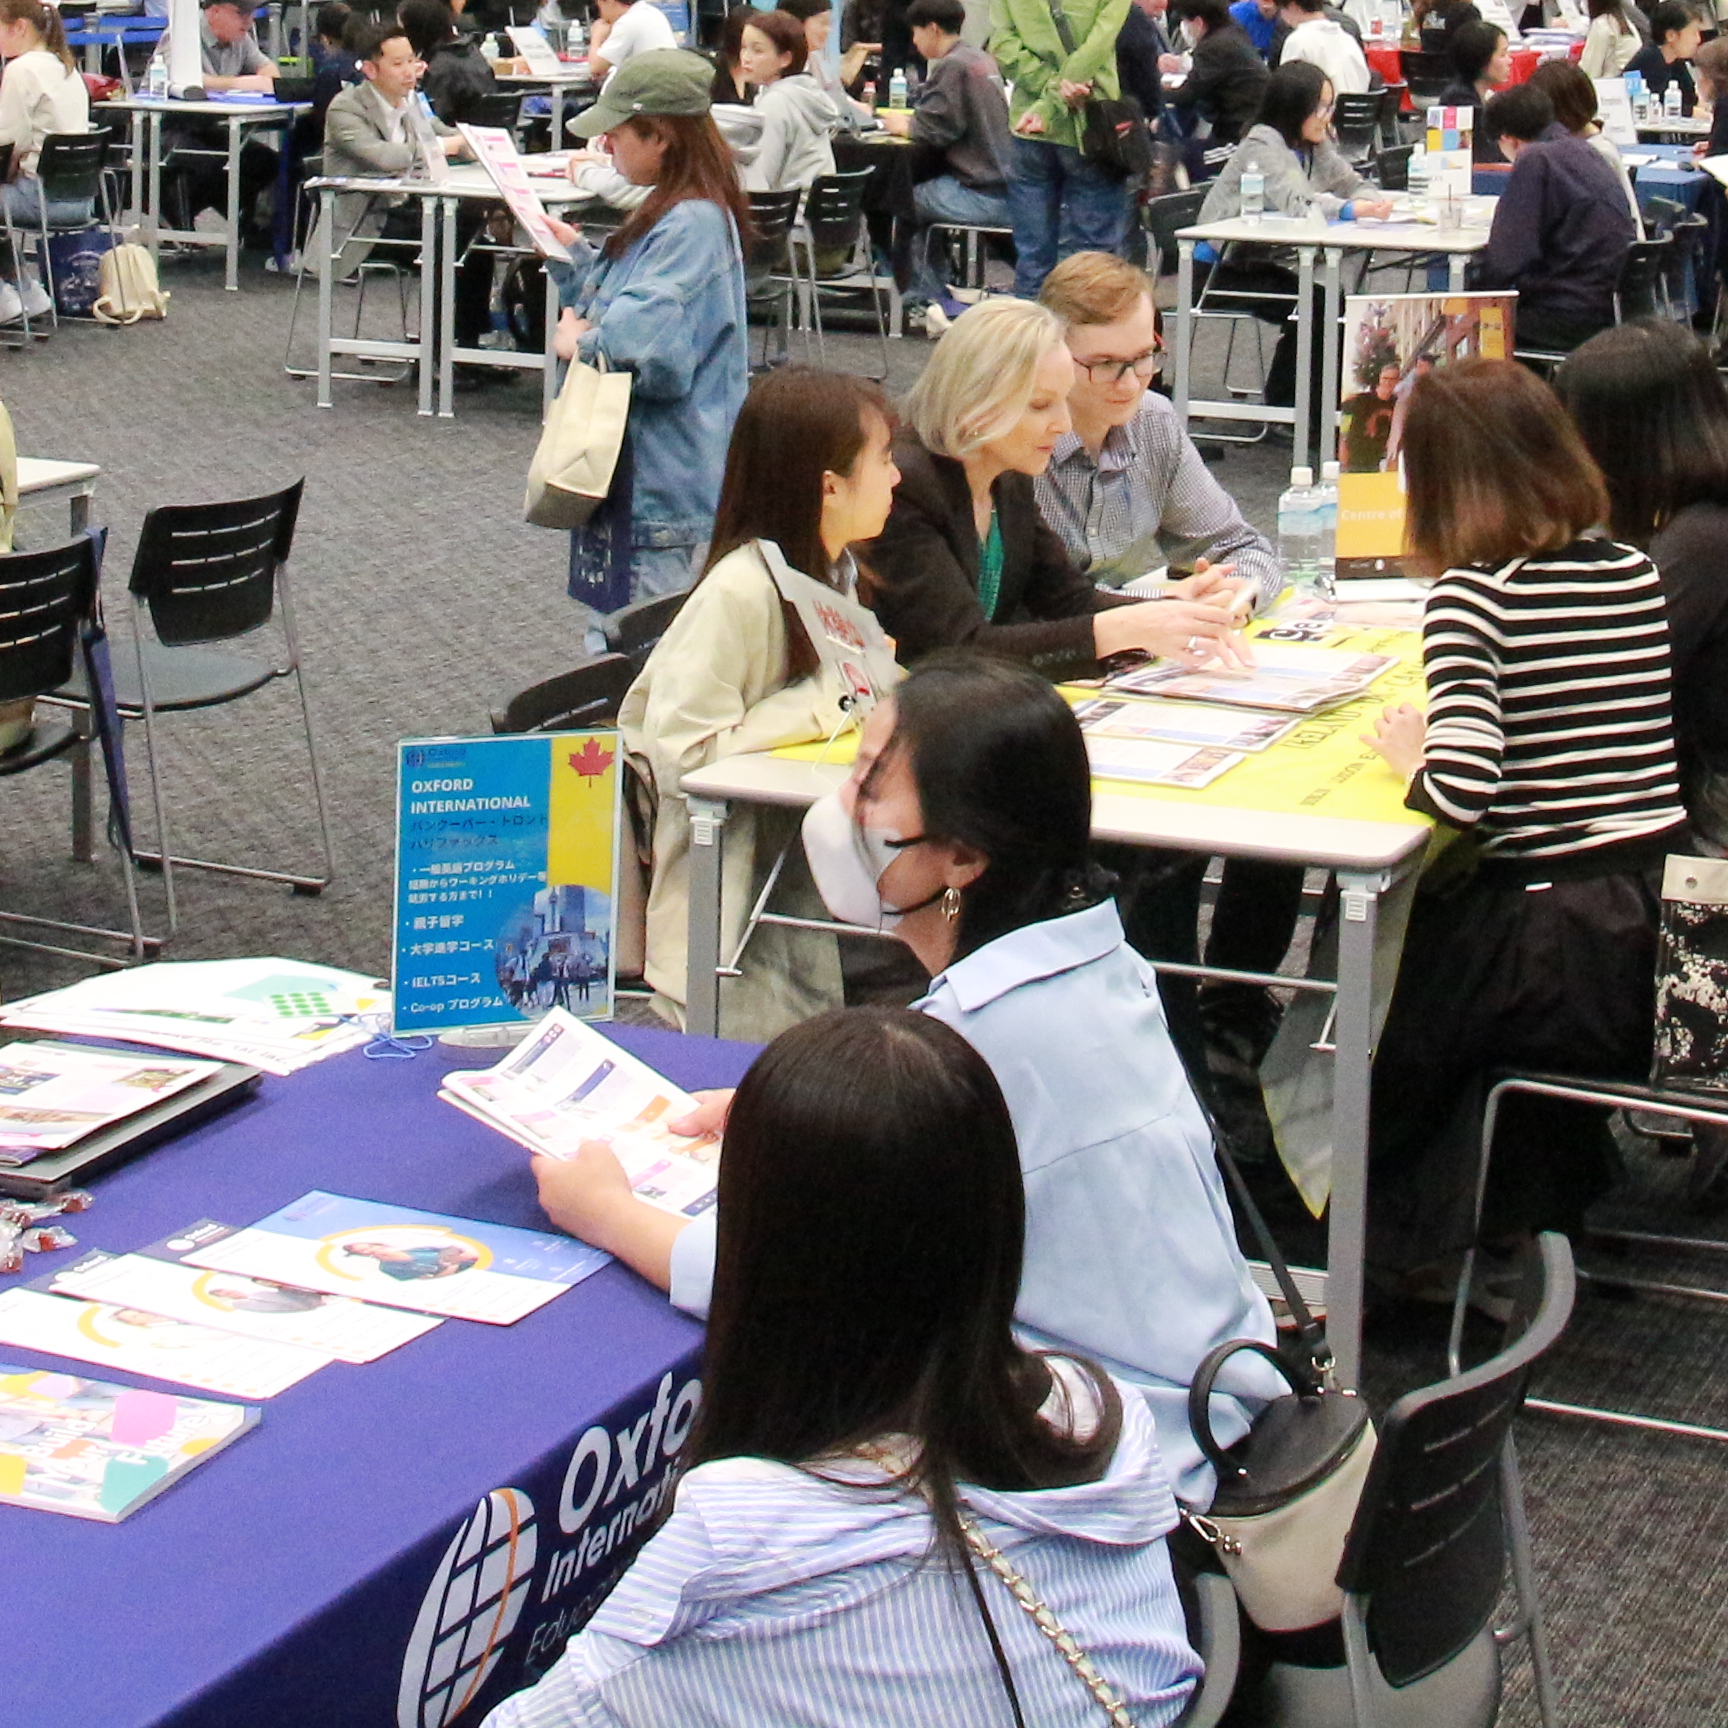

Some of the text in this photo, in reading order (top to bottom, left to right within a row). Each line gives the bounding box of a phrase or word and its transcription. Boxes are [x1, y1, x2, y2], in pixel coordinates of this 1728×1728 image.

[410, 795, 531, 814] INTERNATIONAL
[411, 778, 474, 794] OXFORD
[447, 996, 504, 1011] プログラム
[19, 1417, 98, 1459] Build
[115, 1413, 212, 1466] Future
[558, 1370, 704, 1535] Oxfo
[541, 1454, 683, 1604] Internati
